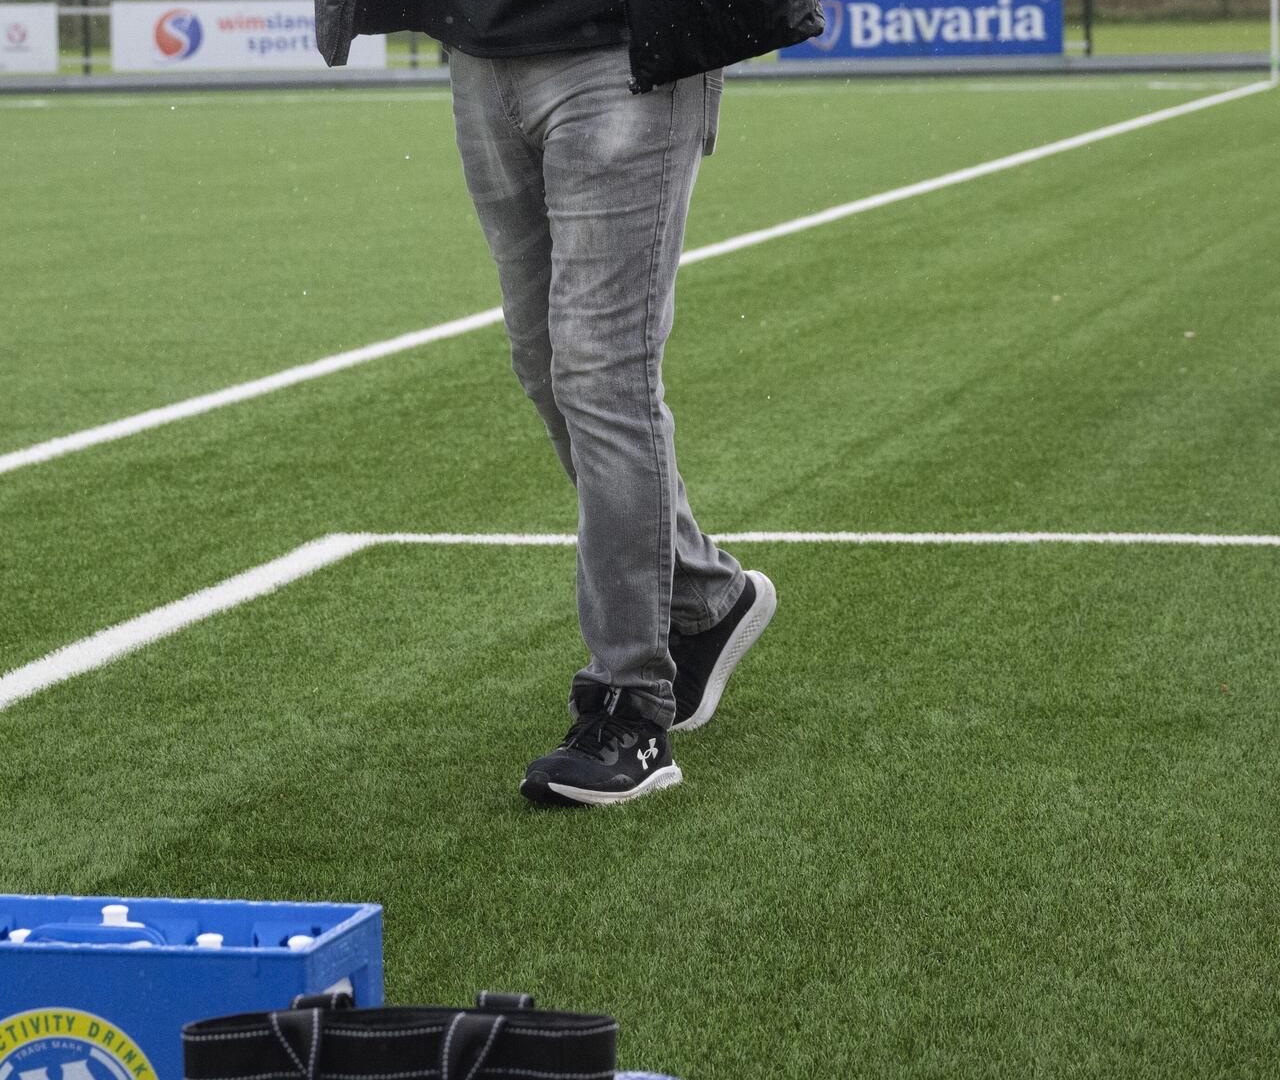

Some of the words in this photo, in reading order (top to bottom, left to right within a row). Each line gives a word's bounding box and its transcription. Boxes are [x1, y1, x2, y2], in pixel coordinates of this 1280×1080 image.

[15, 1041, 48, 1062] TRADE
[51, 1040, 84, 1053] MARK
[87, 1021, 148, 1078] DRINK
